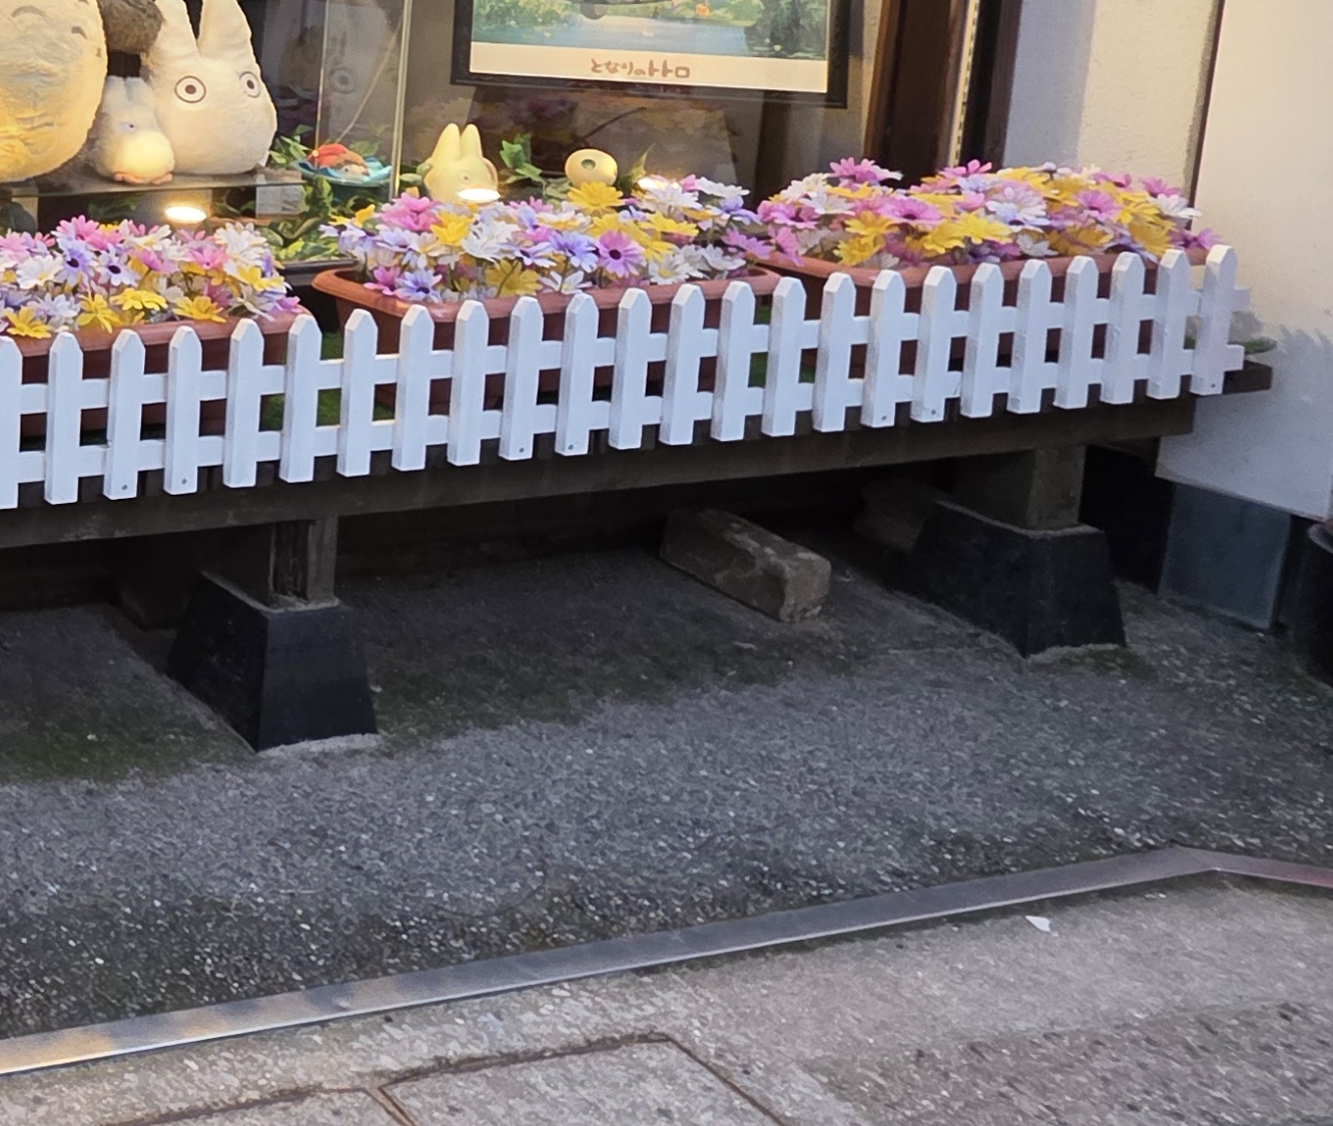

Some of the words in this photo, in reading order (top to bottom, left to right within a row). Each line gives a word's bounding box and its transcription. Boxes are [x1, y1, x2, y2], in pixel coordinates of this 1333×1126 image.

[590, 57, 691, 79] となりのトトロ
